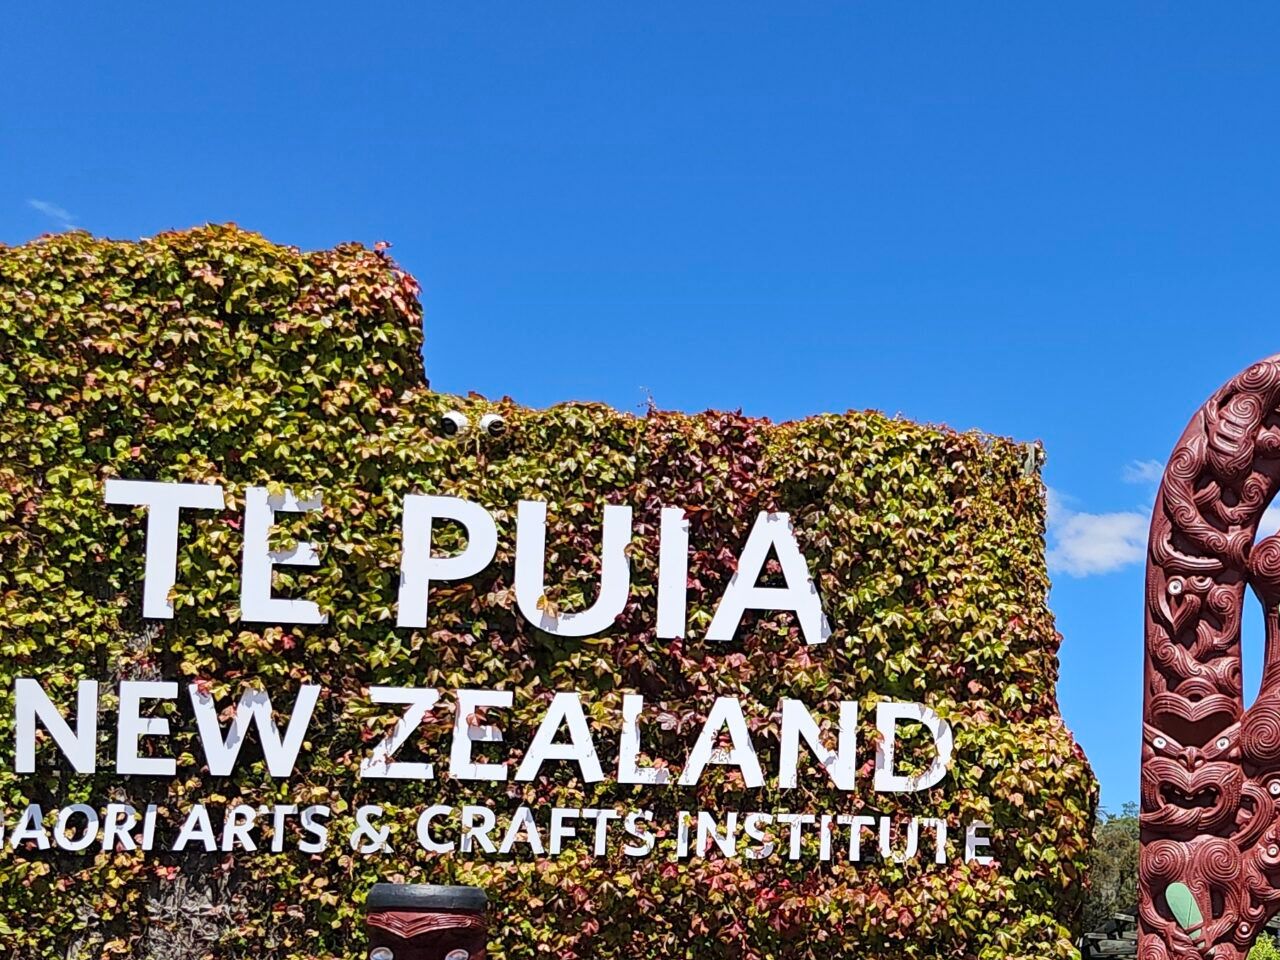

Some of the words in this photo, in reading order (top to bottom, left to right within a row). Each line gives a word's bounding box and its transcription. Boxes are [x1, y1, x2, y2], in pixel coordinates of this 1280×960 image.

[105, 480, 328, 625] TE
[396, 494, 833, 645] PUIA
[14, 678, 321, 778] NEW
[360, 686, 954, 793] ZEALAND
[0, 803, 158, 851] AORI
[175, 804, 330, 853] ARTS
[349, 804, 394, 854] &
[416, 805, 656, 857] CRAFTS
[677, 810, 995, 867] INSTITUTE
